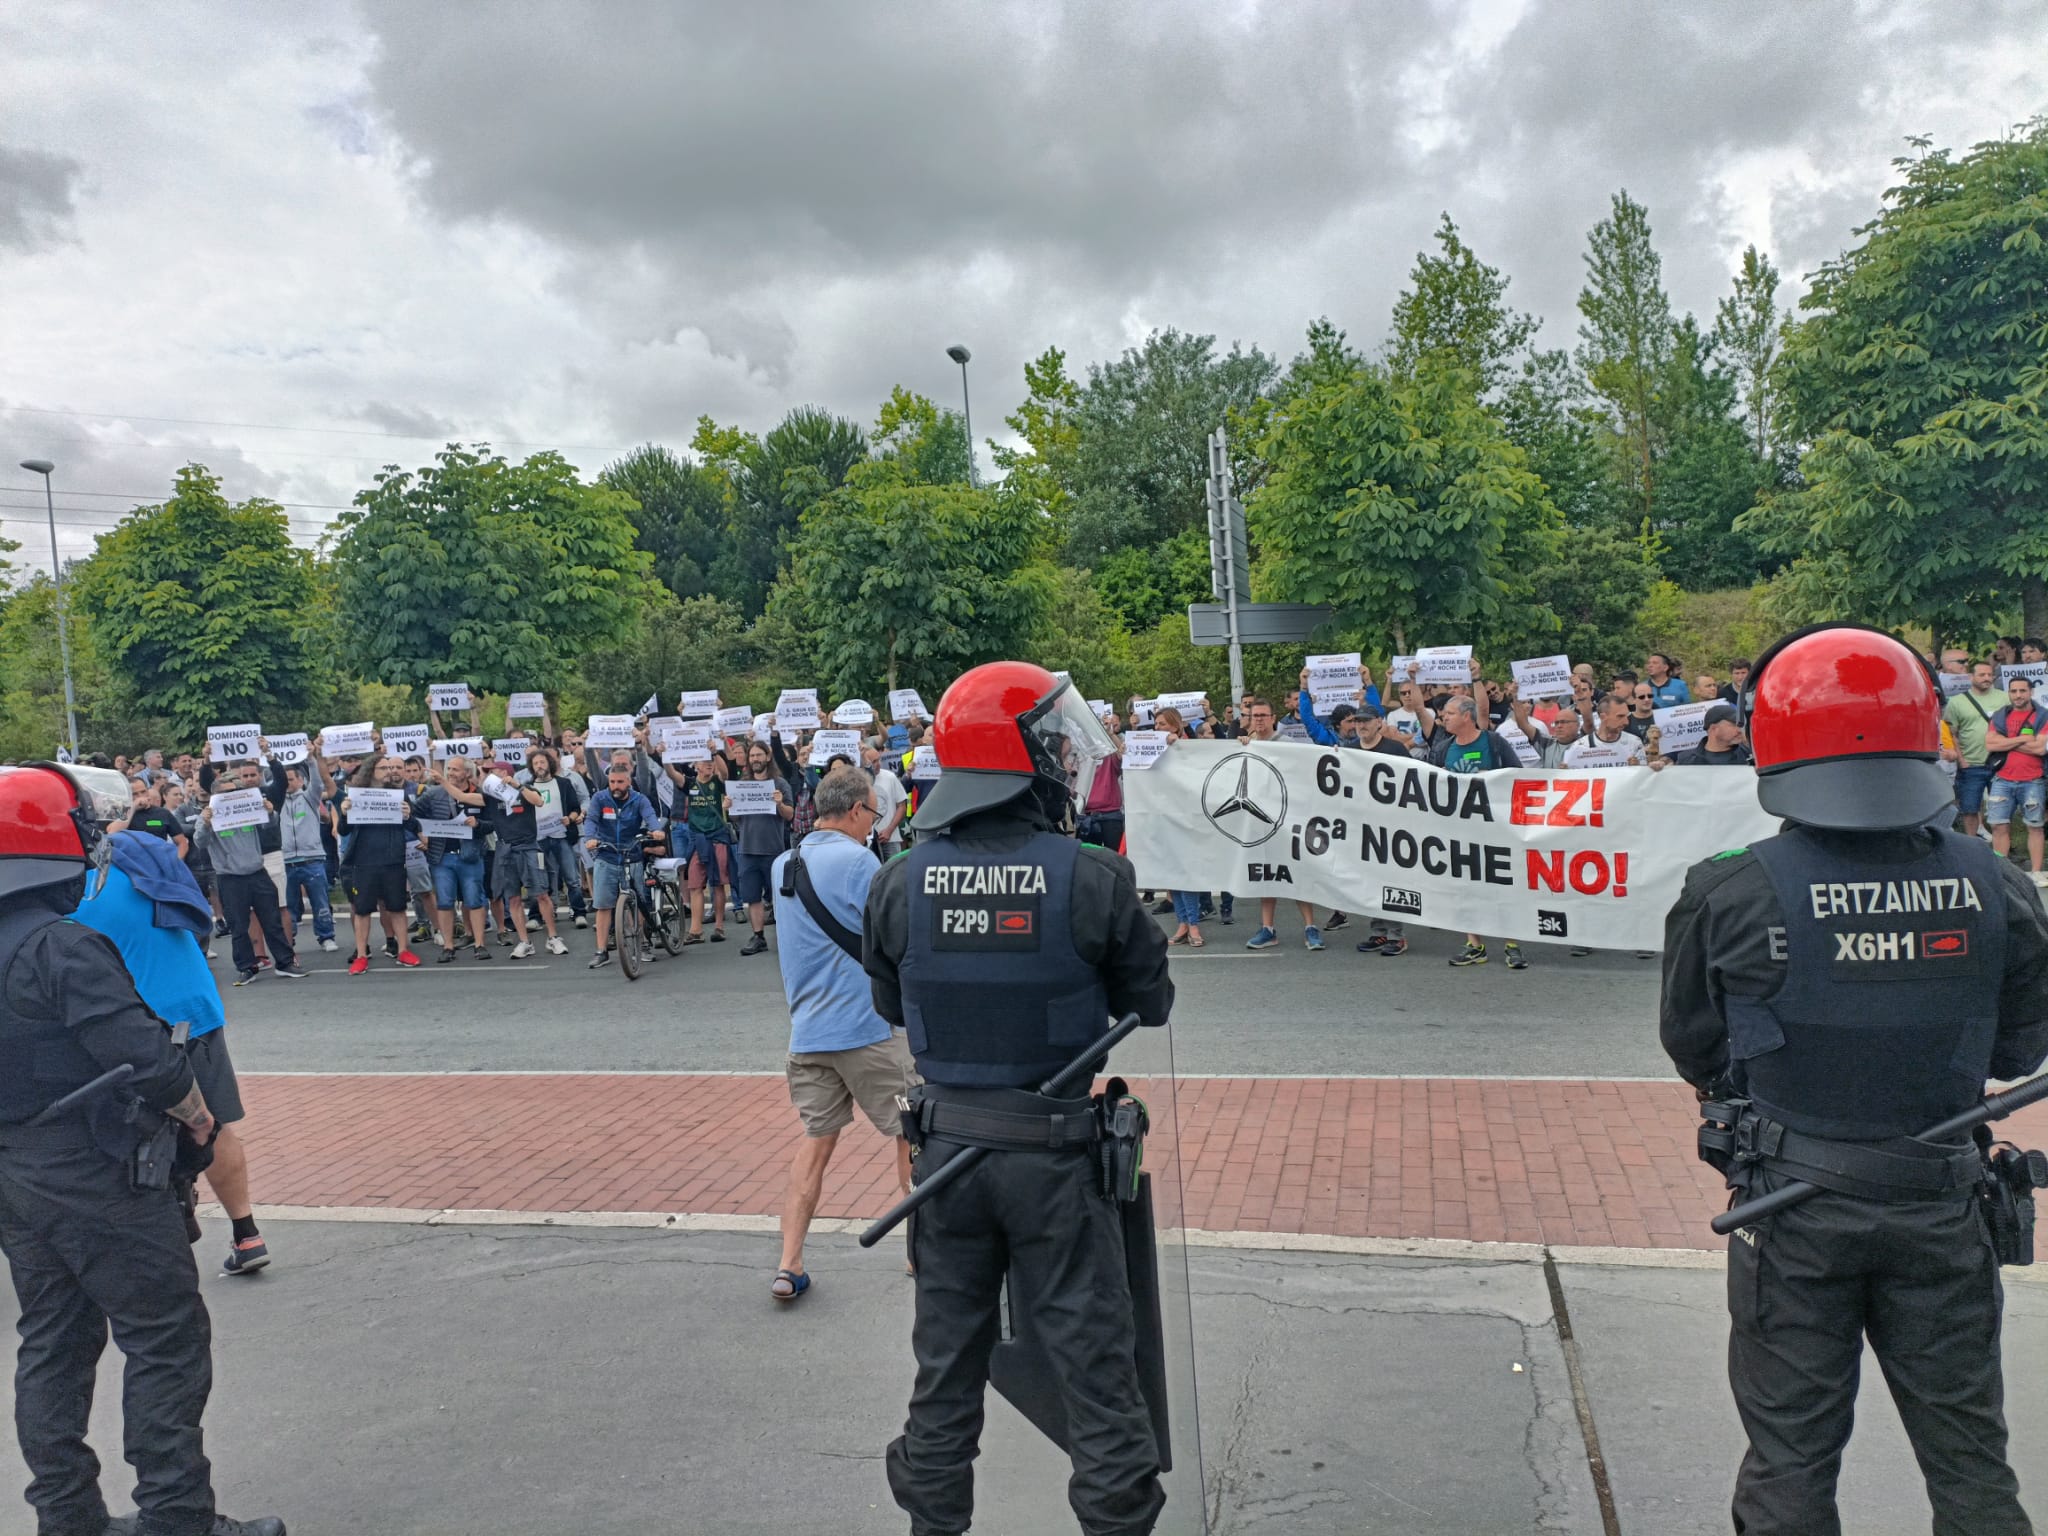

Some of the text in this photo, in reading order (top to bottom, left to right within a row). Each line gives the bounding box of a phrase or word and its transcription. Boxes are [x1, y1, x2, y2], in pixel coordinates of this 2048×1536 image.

[430, 688, 468, 696] DOMINGOS
[441, 697, 459, 706] NO
[209, 730, 258, 740] DOMINGOS
[384, 729, 427, 739] DOMINGOS
[223, 742, 248, 756] NO
[396, 741, 417, 752] NO
[446, 744, 468, 755] NO
[274, 751, 296, 762] NO
[504, 752, 521, 760] NO
[1317, 754, 1606, 828] 6. GAUA EZ!
[1361, 824, 1514, 886] NOCHE
[1526, 849, 1628, 897] NO!
[924, 866, 1047, 894] ERTZAINTZA
[1248, 863, 1293, 884] ELA
[1386, 889, 1420, 906] LAB
[1810, 877, 1983, 918] ERTZAINTZA
[942, 909, 989, 934] F2P9
[1834, 932, 1916, 960] X6H1
